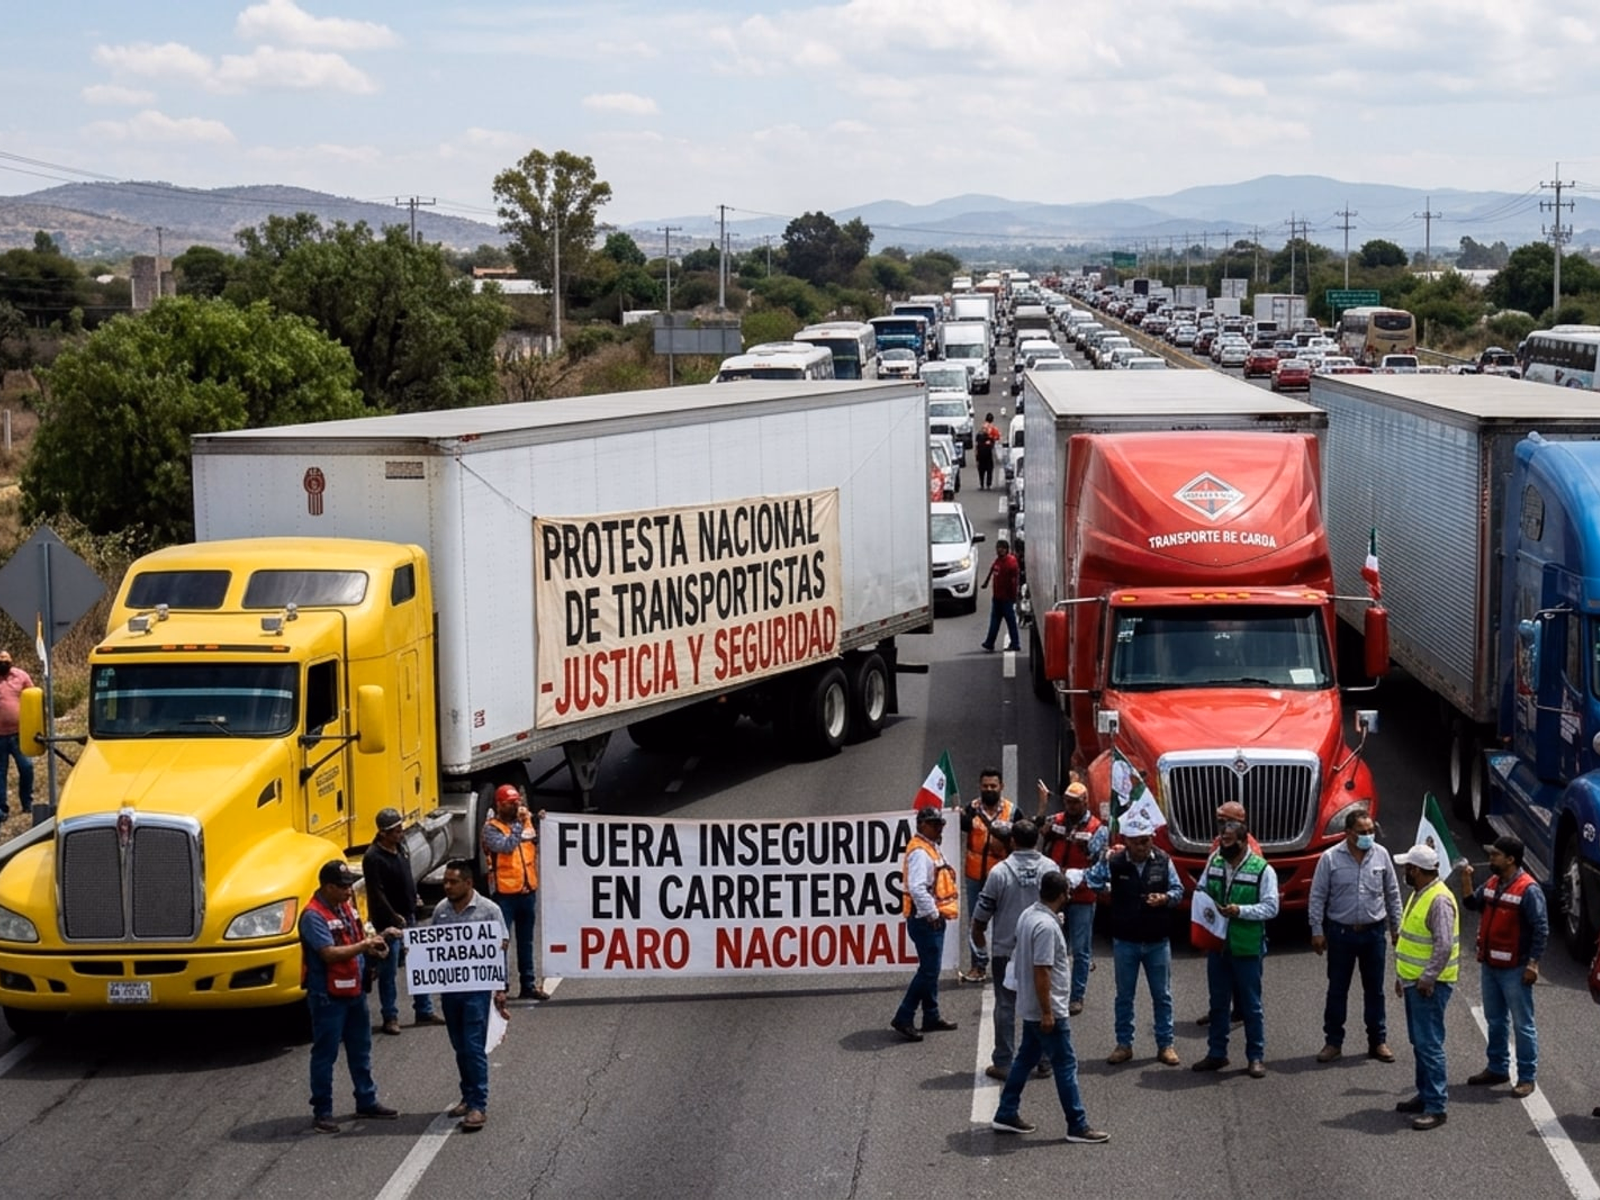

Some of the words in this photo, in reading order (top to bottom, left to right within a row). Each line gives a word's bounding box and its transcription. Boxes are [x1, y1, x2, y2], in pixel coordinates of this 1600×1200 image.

[542, 514, 689, 581] PROTESTA
[698, 498, 820, 563] NACIONAL
[1148, 530, 1221, 549] TRANSPORTE
[1222, 530, 1238, 544] BE
[565, 587, 602, 647] DE
[612, 550, 826, 638] TRANSPORTISTAS
[687, 634, 704, 685] Y
[714, 606, 837, 681] SEGURIDAD
[558, 822, 683, 867] FUERA
[591, 875, 641, 920] EN
[659, 871, 904, 920] CARRETERAS
[408, 925, 473, 945] RESPSTO
[477, 923, 497, 940] AL
[426, 944, 497, 962] TRABAJO
[580, 927, 690, 970] PARO
[715, 922, 920, 969] NACIONAL
[412, 966, 470, 986] BLOQUEO
[471, 965, 505, 982] TOTAL
